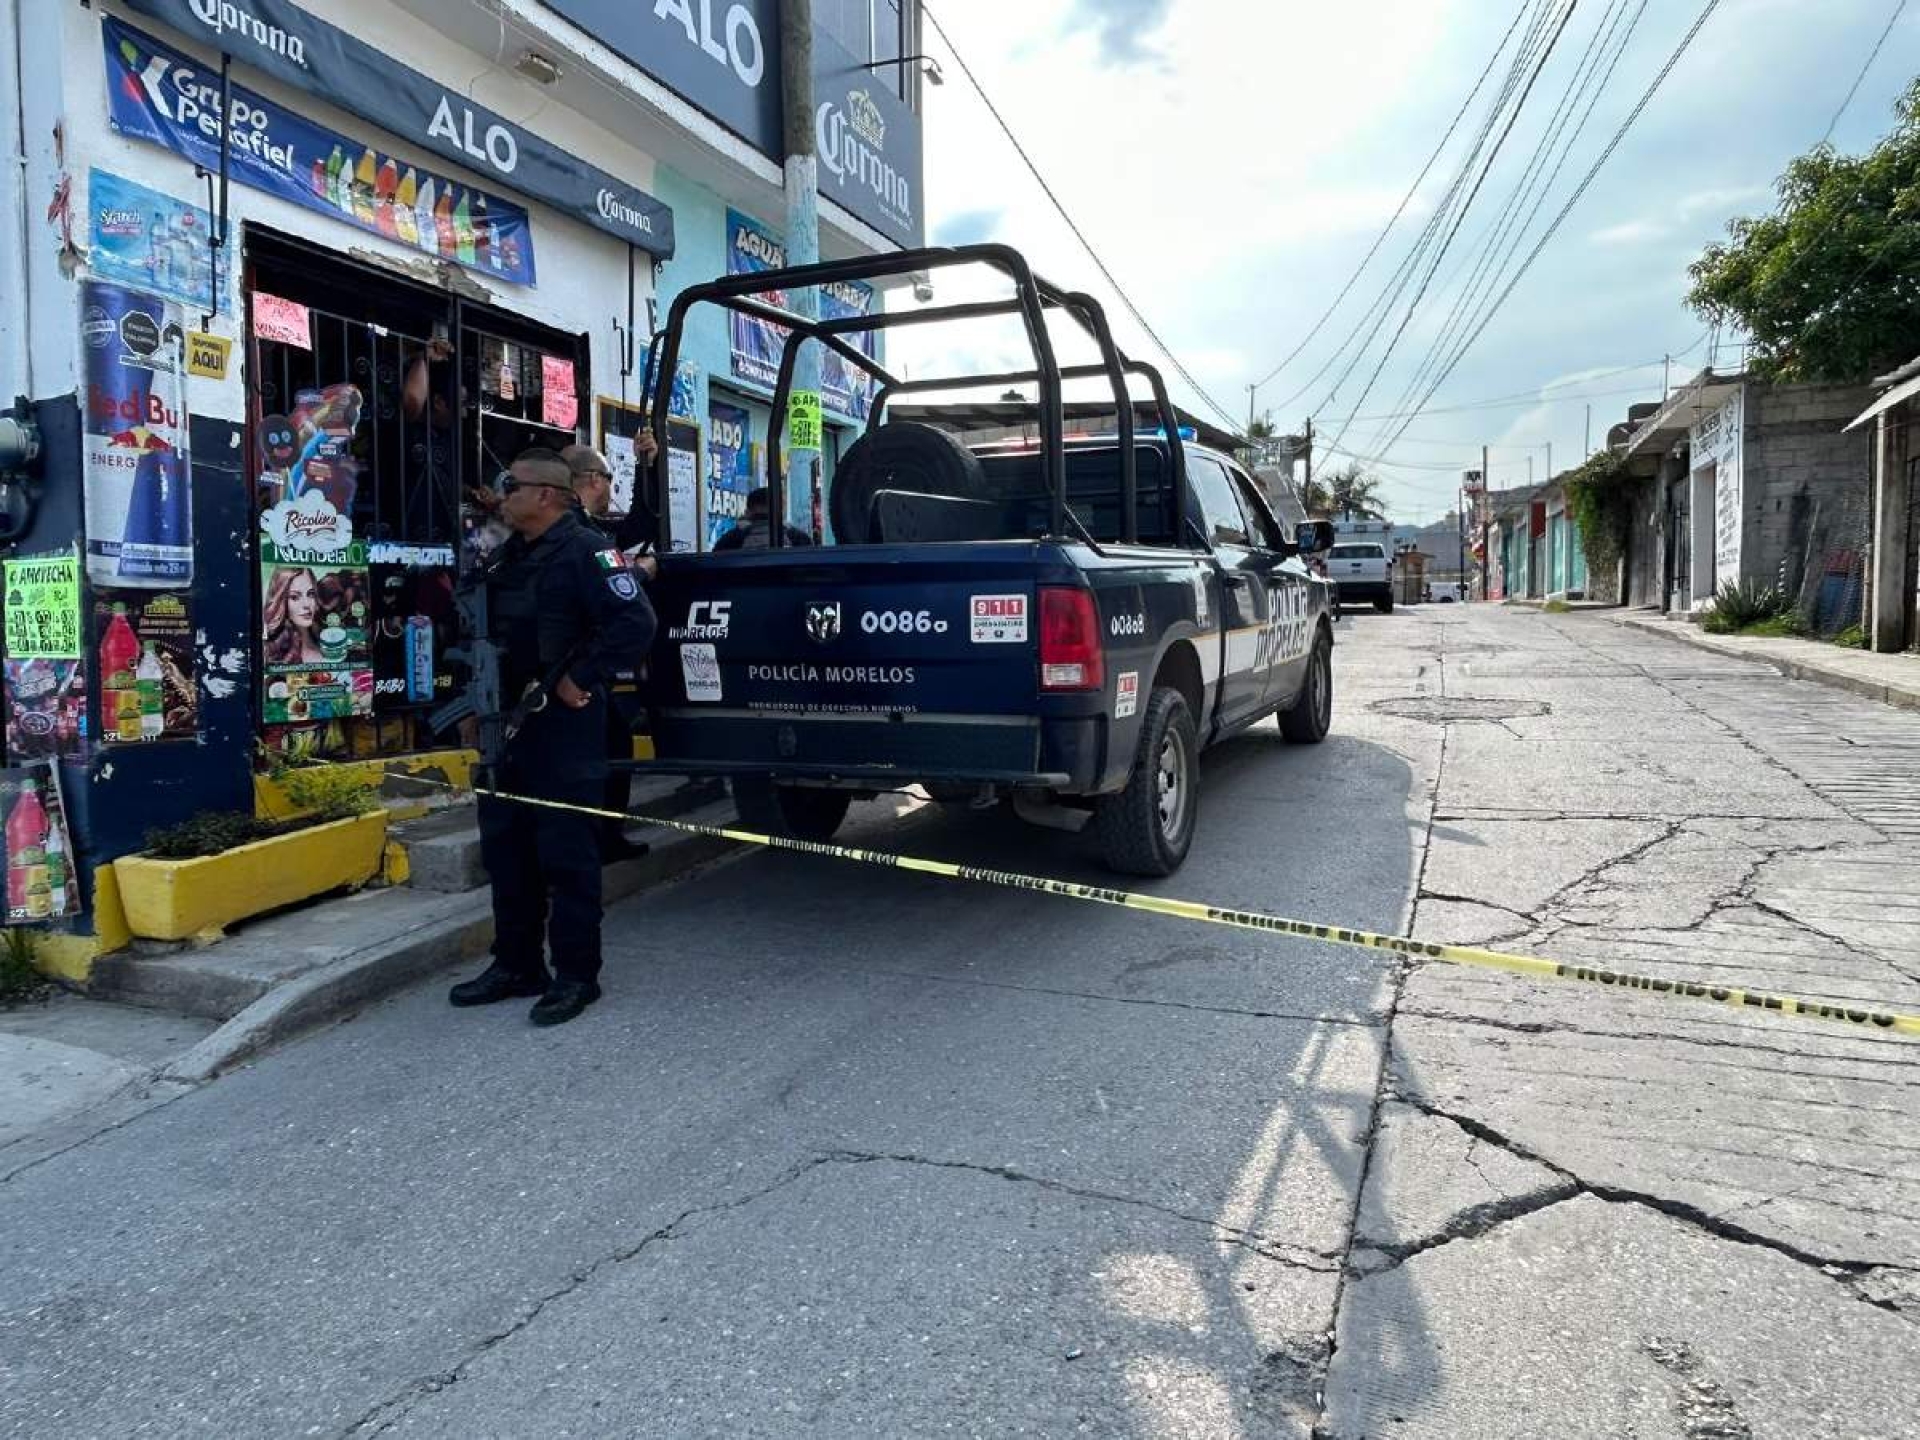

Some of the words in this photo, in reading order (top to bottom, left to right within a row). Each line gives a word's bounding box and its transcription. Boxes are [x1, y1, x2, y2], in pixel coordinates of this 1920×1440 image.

[427, 95, 518, 174] ALO
[736, 226, 787, 269] AGUA
[977, 601, 1019, 614] 911
[749, 663, 819, 682] POLICÍA
[826, 667, 915, 683] MORELOS
